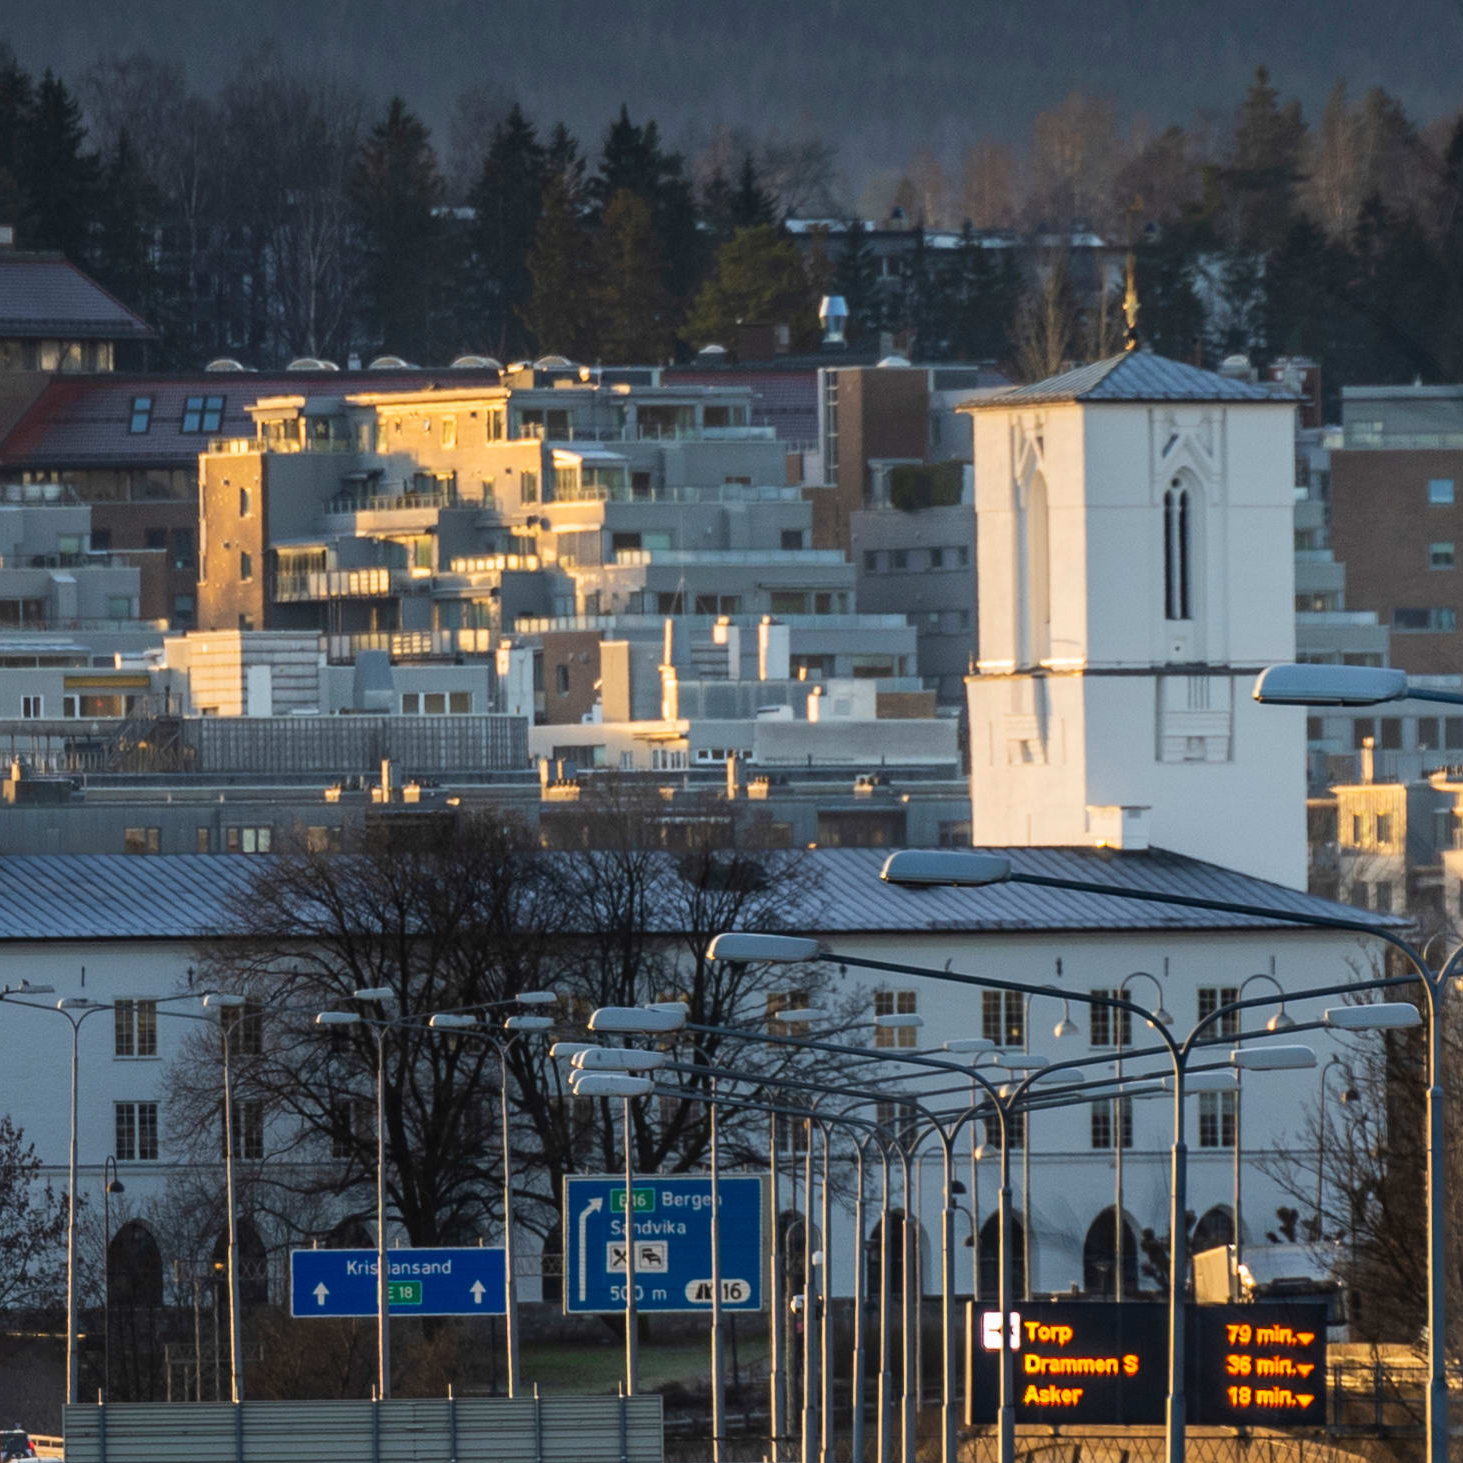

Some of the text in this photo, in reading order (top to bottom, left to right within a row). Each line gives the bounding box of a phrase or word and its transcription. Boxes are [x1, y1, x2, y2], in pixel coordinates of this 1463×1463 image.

[346, 1259, 452, 1276] Krisiansand
[399, 1286, 413, 1299] 18
[652, 1289, 667, 1300] m
[723, 1283, 742, 1300] 16
[1024, 1321, 1297, 1346] Torp 79 min.
[1024, 1354, 1297, 1376] Drammen S 36 min.
[1024, 1385, 1297, 1406] Asker 18 min.
